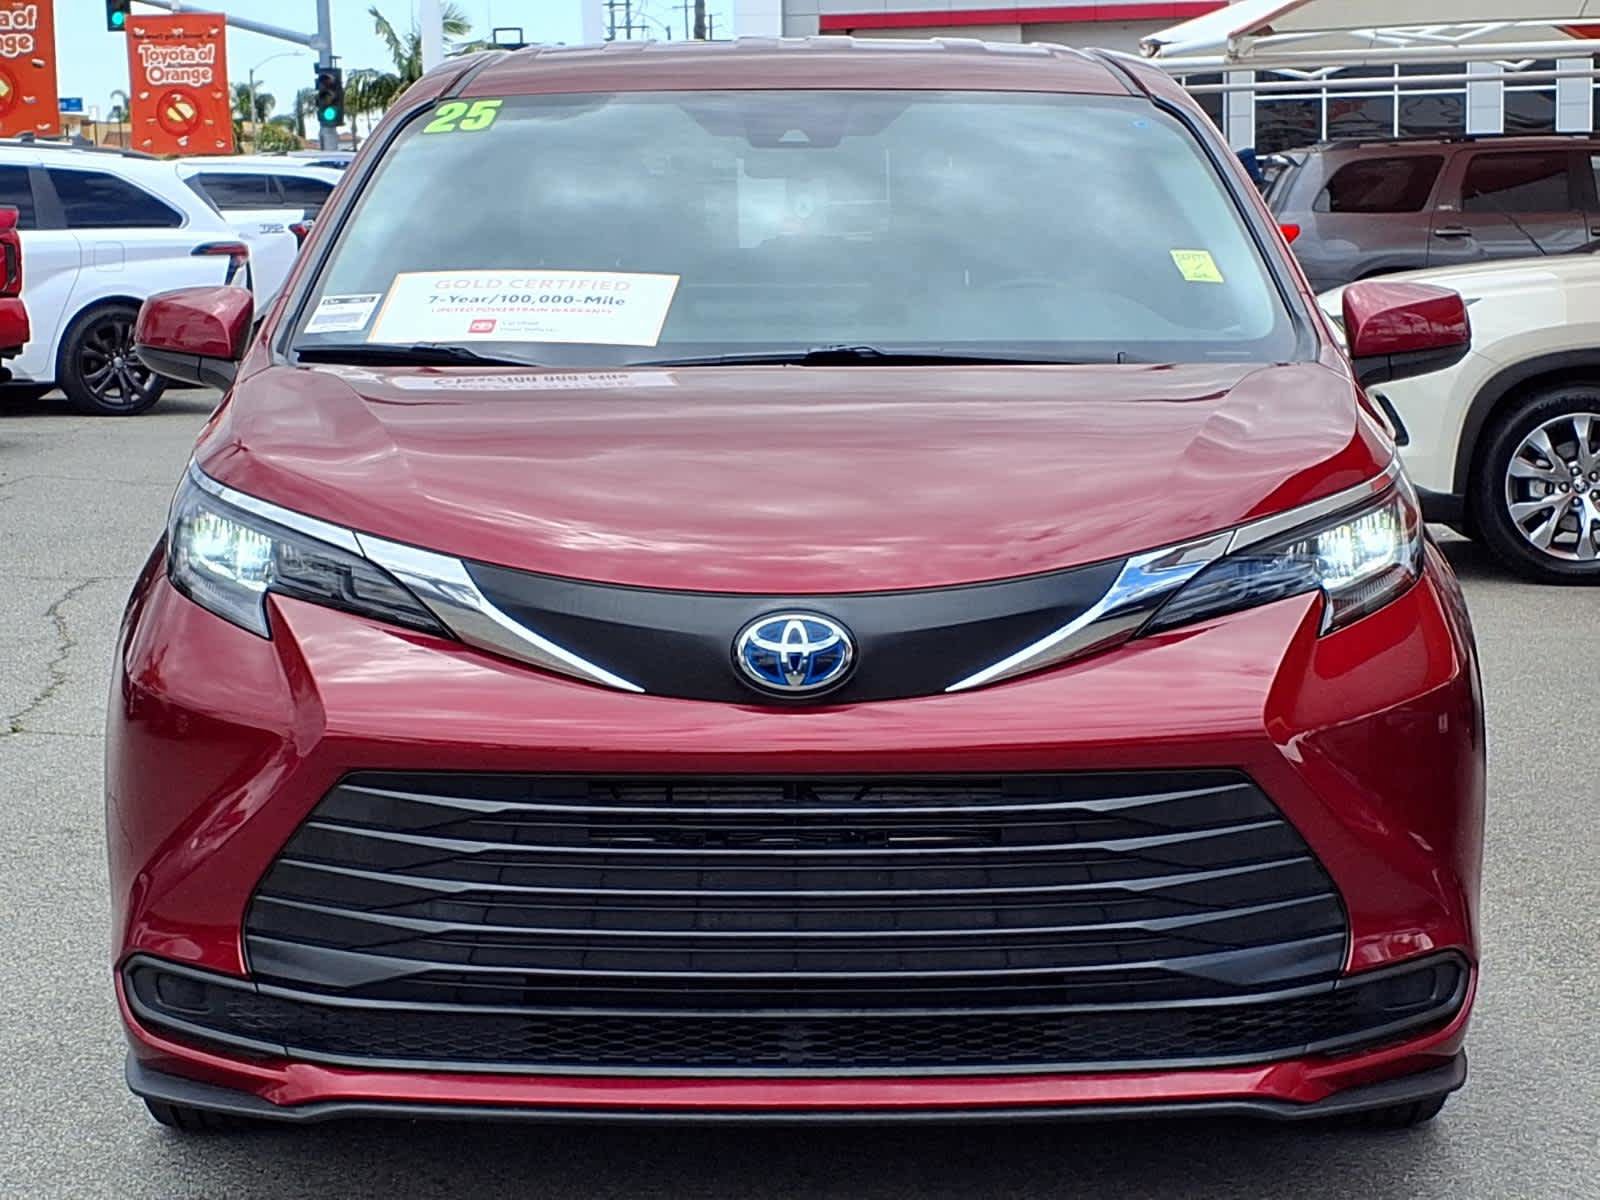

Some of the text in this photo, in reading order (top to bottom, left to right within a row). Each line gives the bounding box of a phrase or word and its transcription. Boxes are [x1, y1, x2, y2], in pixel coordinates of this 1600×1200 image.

[12, 6, 36, 28] of
[140, 44, 214, 66] Toyota of
[147, 66, 211, 86] Orange
[423, 99, 503, 133] 25
[434, 279, 631, 291] GOLD CERTIFIED
[429, 293, 625, 306] 7-Year/100,000-Mile
